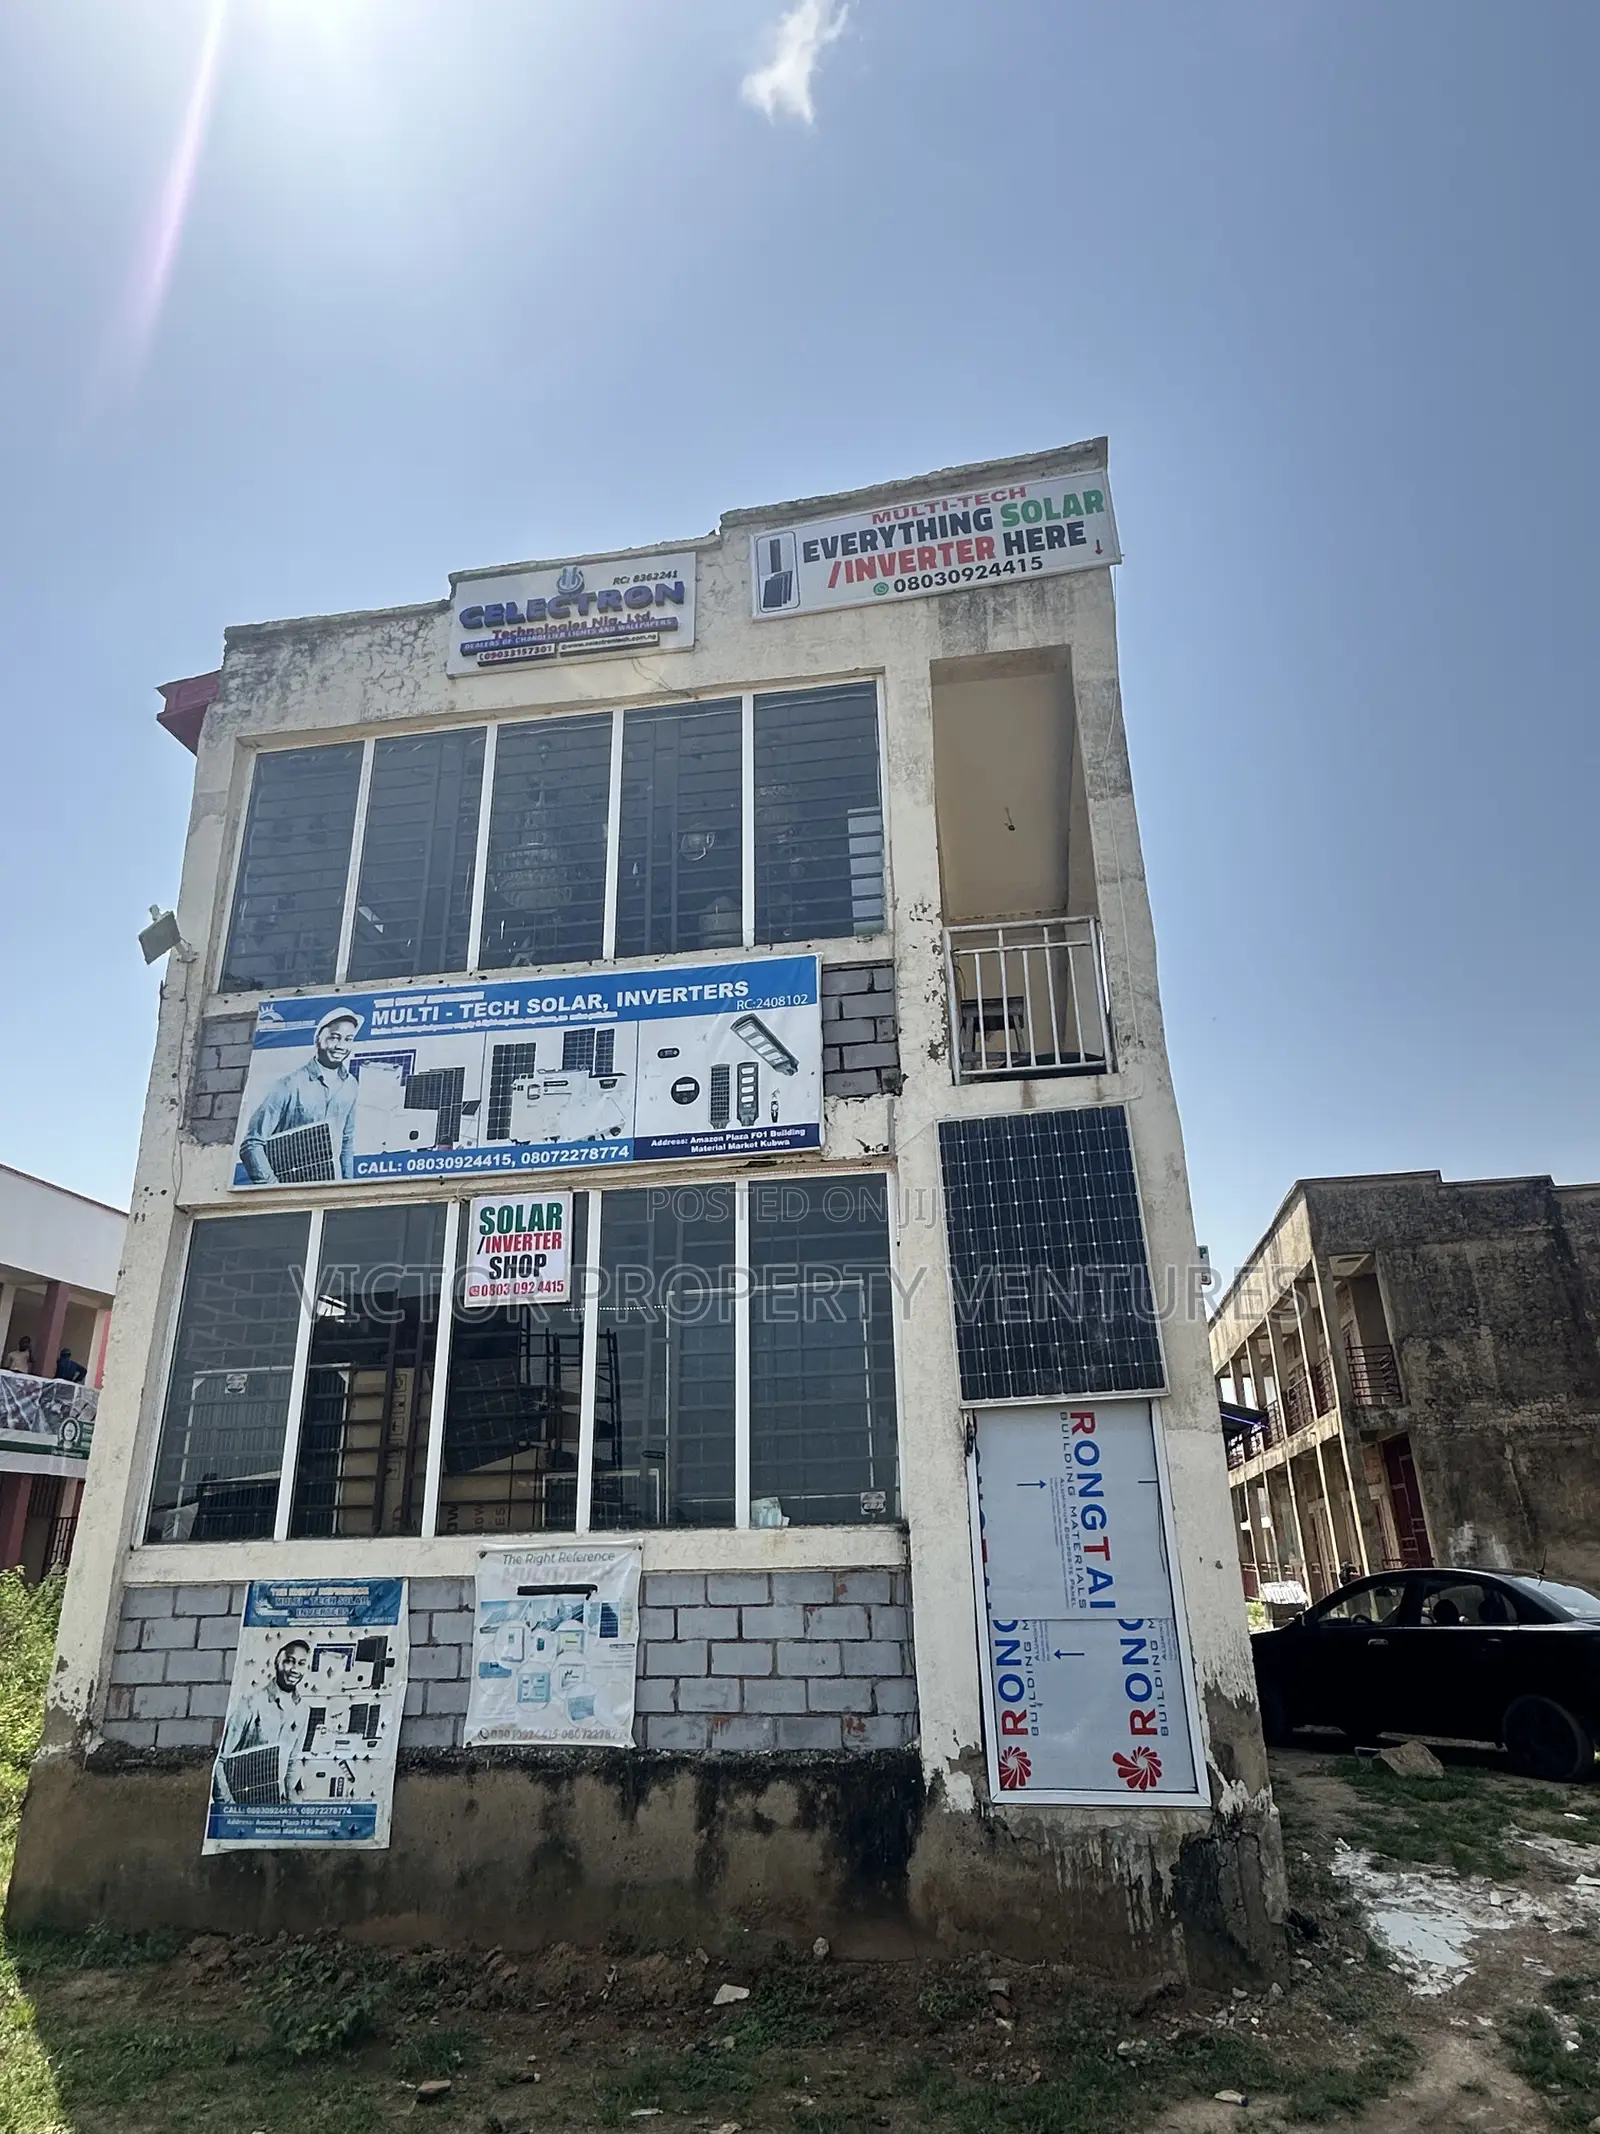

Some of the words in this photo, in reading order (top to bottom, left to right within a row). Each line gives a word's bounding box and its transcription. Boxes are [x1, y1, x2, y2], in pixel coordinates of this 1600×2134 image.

[872, 486, 1027, 525] MULTI-TECH
[803, 507, 993, 564] EVERYTHING
[1001, 489, 1105, 527] SOLAR
[827, 535, 996, 589] /INVERTER
[1003, 520, 1087, 557] HERE
[633, 570, 678, 583] 8362241
[893, 555, 1044, 594] 08030924415
[459, 580, 686, 629] CELECTRON
[492, 620, 588, 639] Technologies
[626, 611, 655, 623] Ltd.
[371, 1005, 440, 1026] MULTI
[459, 1000, 520, 1019] TECH
[527, 993, 609, 1014] SOLAR,
[616, 981, 749, 1009] INVERTERS
[736, 994, 809, 1011] RC:2408102
[651, 1138, 688, 1147] Address:
[690, 1135, 724, 1144] Amazon
[725, 1133, 749, 1142] Plaza
[770, 1128, 806, 1138] Building
[691, 1144, 726, 1153] Material
[728, 1141, 758, 1151] Market
[760, 1139, 791, 1148] Kubwa
[357, 1160, 403, 1175] CALL:
[407, 1152, 516, 1171] 08030924415,
[520, 1145, 630, 1166] 08072278774
[479, 1202, 563, 1235] SOLAR
[477, 1232, 562, 1254] /INVERTER
[489, 1254, 547, 1280] SHOP
[481, 1283, 510, 1297] 0803
[513, 1281, 536, 1295] 092
[537, 1280, 564, 1293] 4415
[1060, 1411, 1076, 1497] BUILDING
[1069, 1506, 1087, 1609] MATERIALS
[1069, 1411, 1117, 1609] RONGTAI
[503, 1554, 522, 1565] The
[525, 1552, 555, 1567] Right
[558, 1551, 616, 1564] Reference
[1024, 1641, 1039, 1736] BUILDING
[1150, 1640, 1169, 1736] BUILDING
